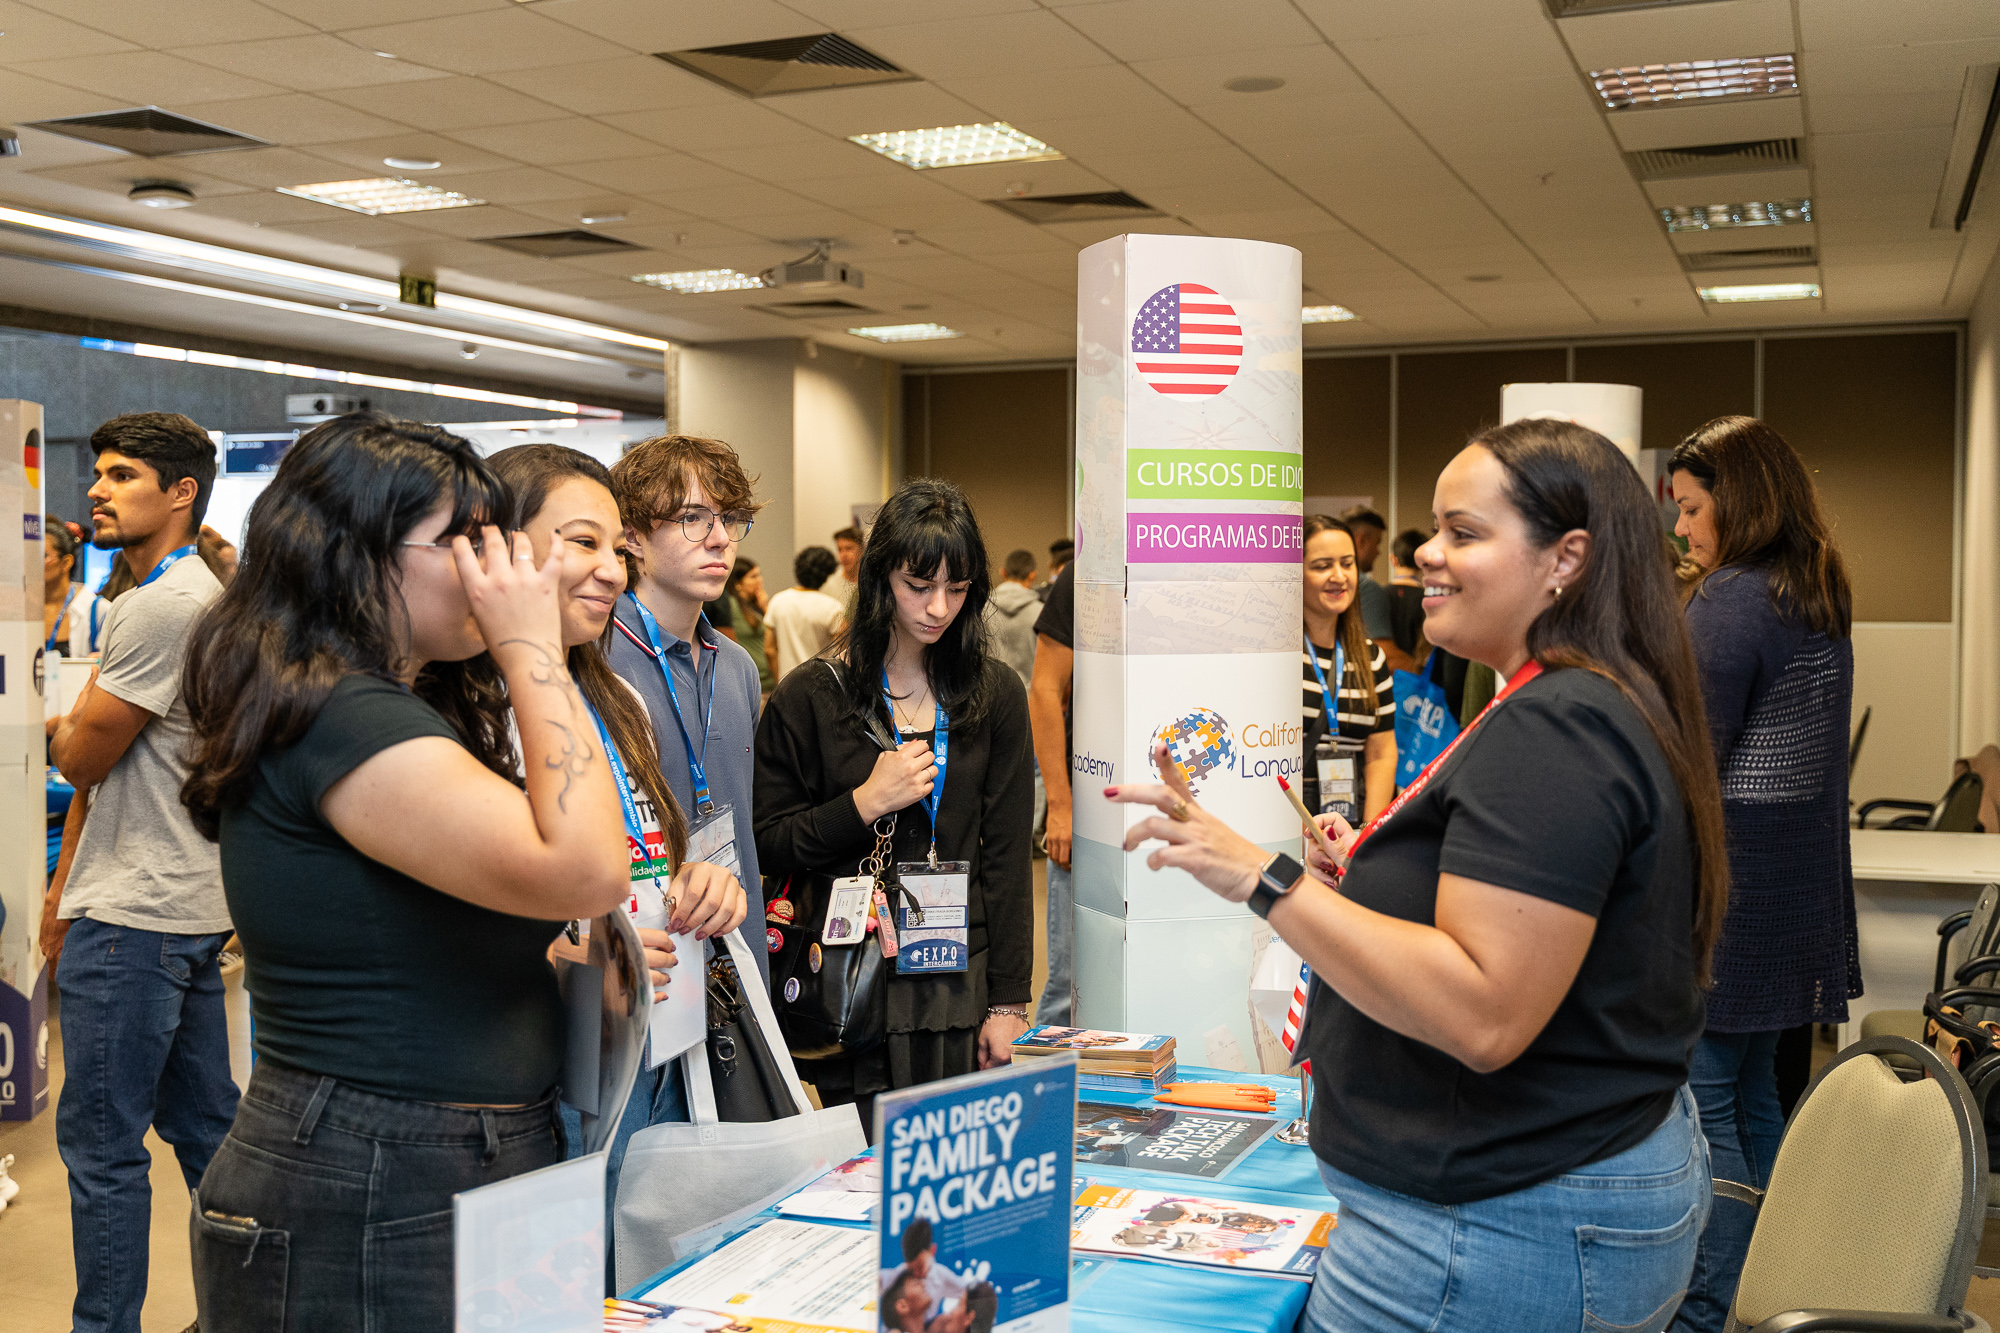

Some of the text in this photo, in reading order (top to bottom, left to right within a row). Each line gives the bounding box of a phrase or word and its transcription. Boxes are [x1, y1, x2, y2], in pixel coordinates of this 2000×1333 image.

[1137, 461, 1243, 487] CURSOS
[1250, 463, 1276, 487] DE
[1136, 524, 1267, 549] PROGRAMAS
[1272, 526, 1289, 549] DE
[1241, 755, 1303, 781] Langua
[923, 946, 957, 961] EXPO
[892, 1091, 1023, 1149] SAN DIEGO
[1137, 1116, 1211, 1160] PACKAGE
[1198, 1121, 1250, 1159] SAN FRANCISCO
[891, 1119, 1021, 1191] FAMILY
[1163, 1120, 1236, 1162] TECH TALK
[889, 1151, 1057, 1236] PACKAGE
